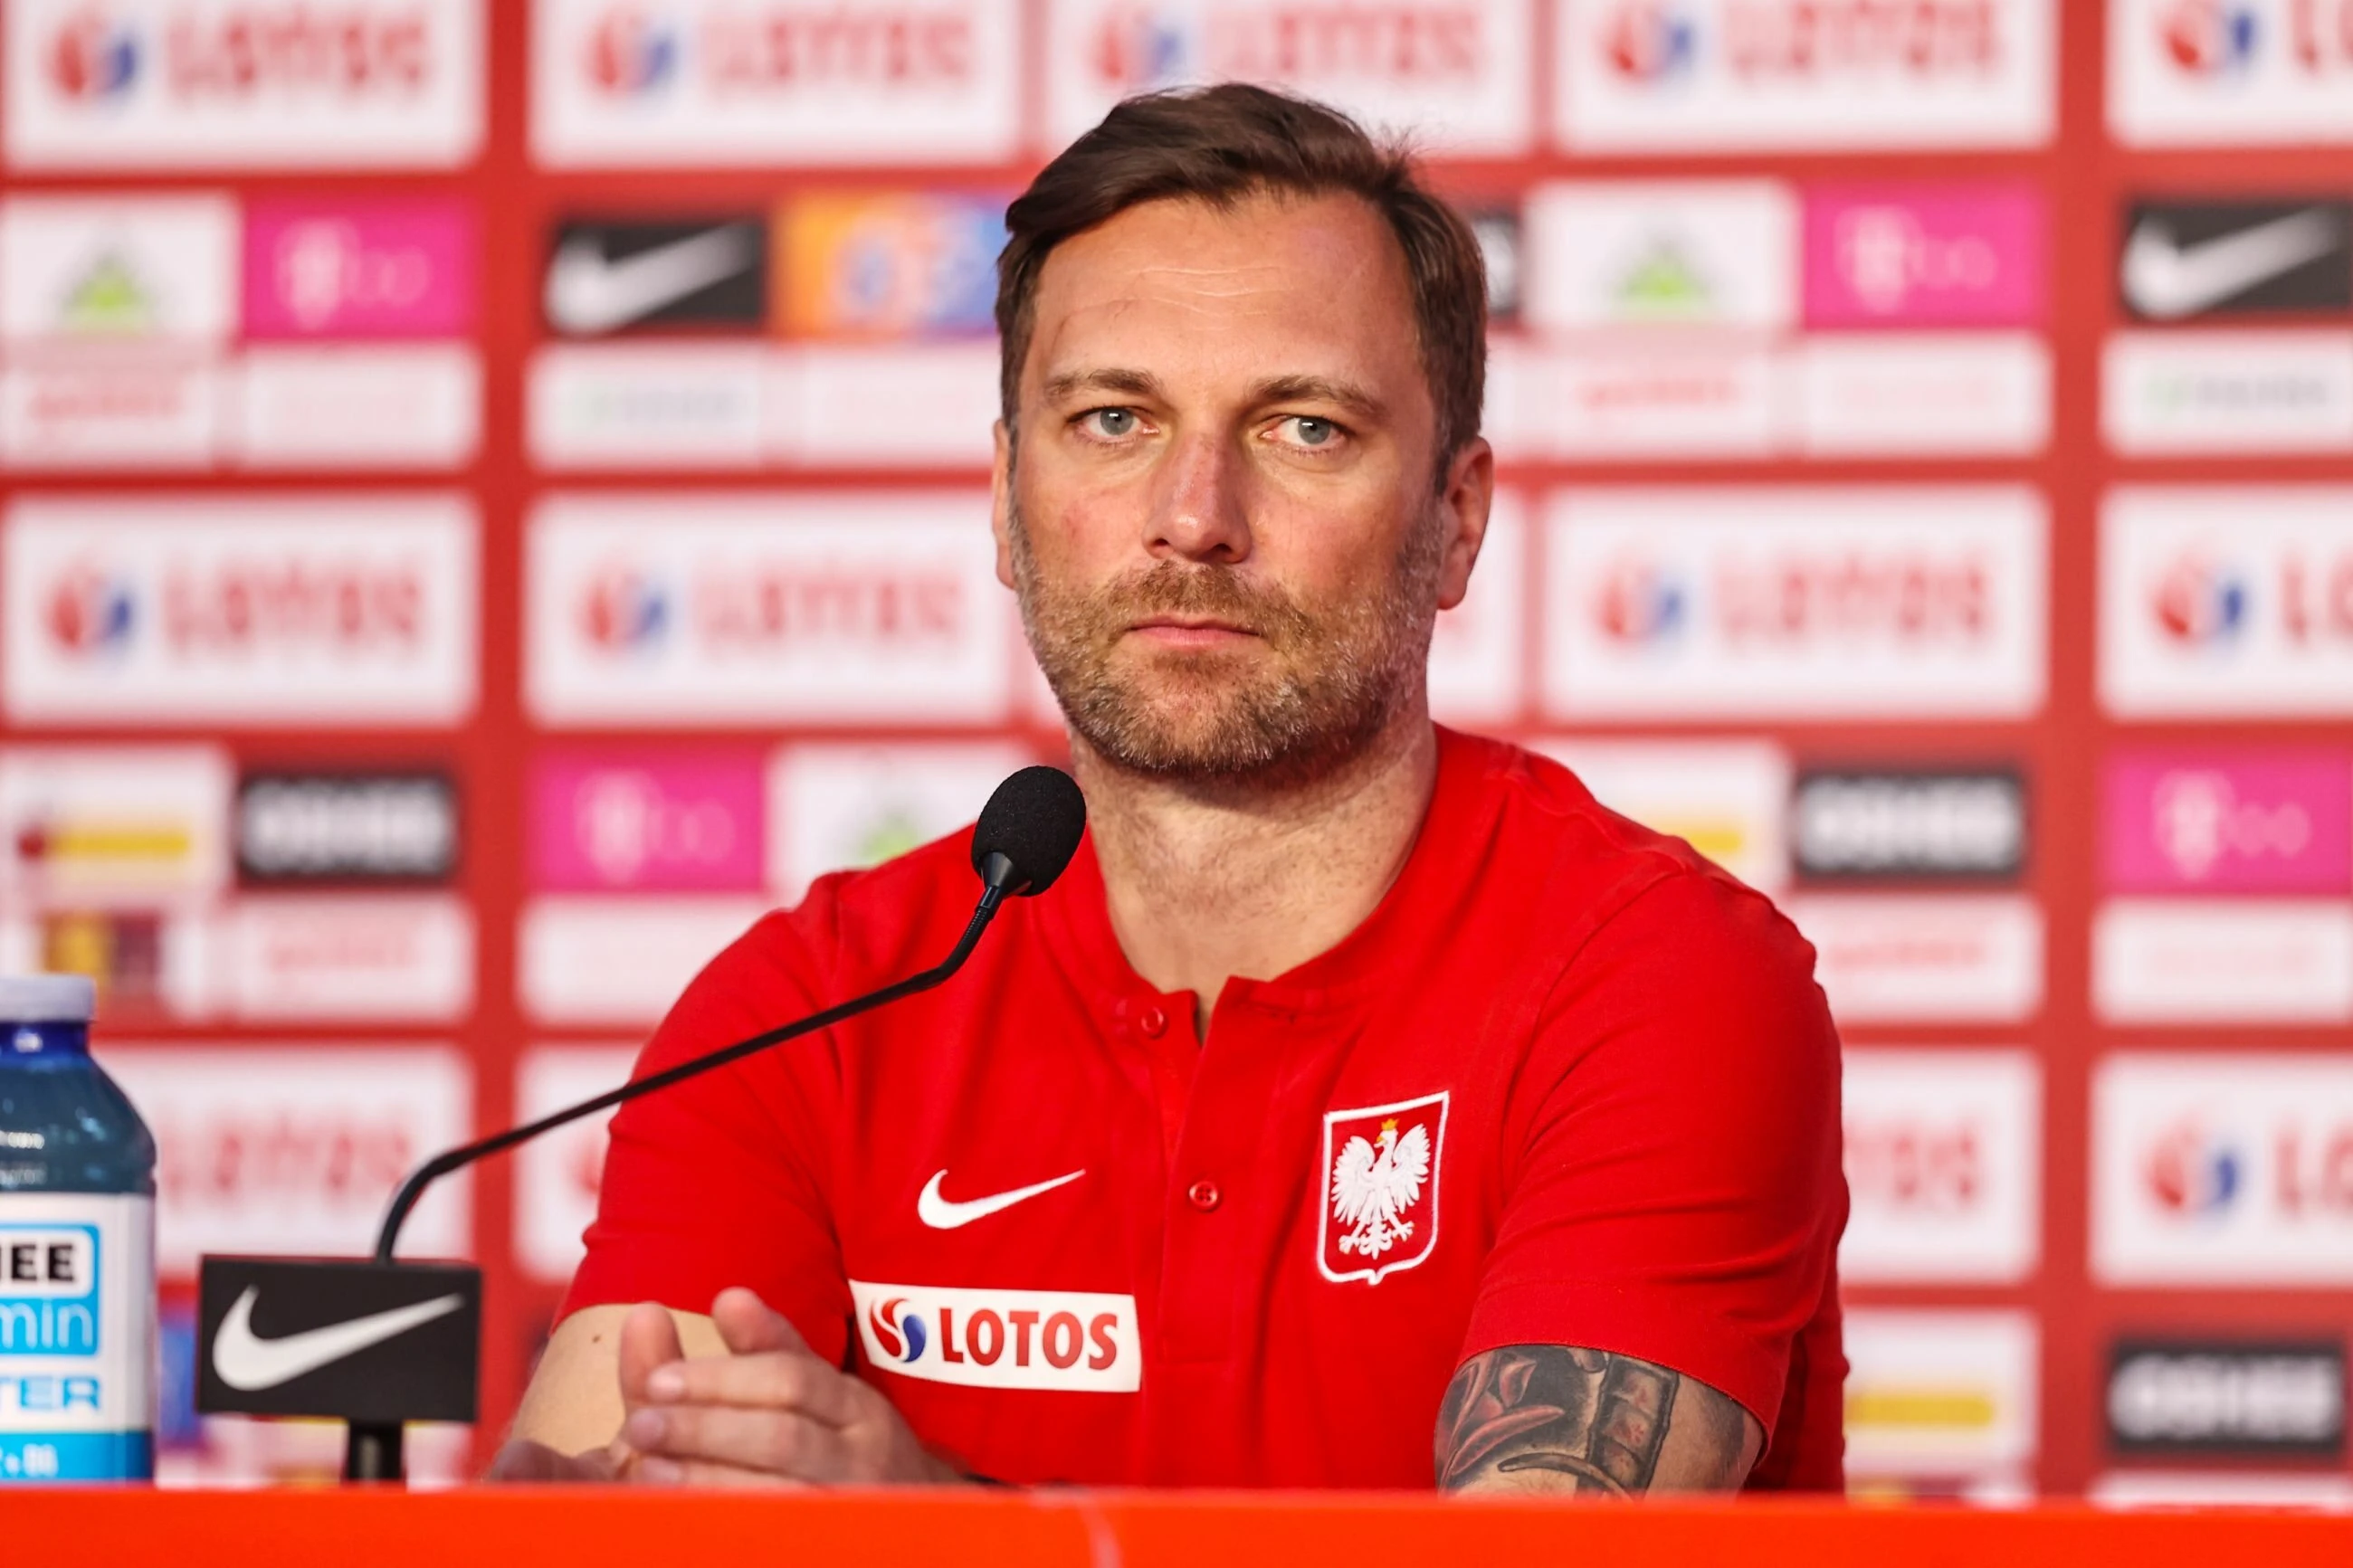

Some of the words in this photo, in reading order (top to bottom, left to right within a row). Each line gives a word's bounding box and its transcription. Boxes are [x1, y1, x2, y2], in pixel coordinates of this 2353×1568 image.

[0, 1242, 76, 1283] EE
[938, 1307, 1119, 1371] LOTOS
[0, 1374, 100, 1411] ER
